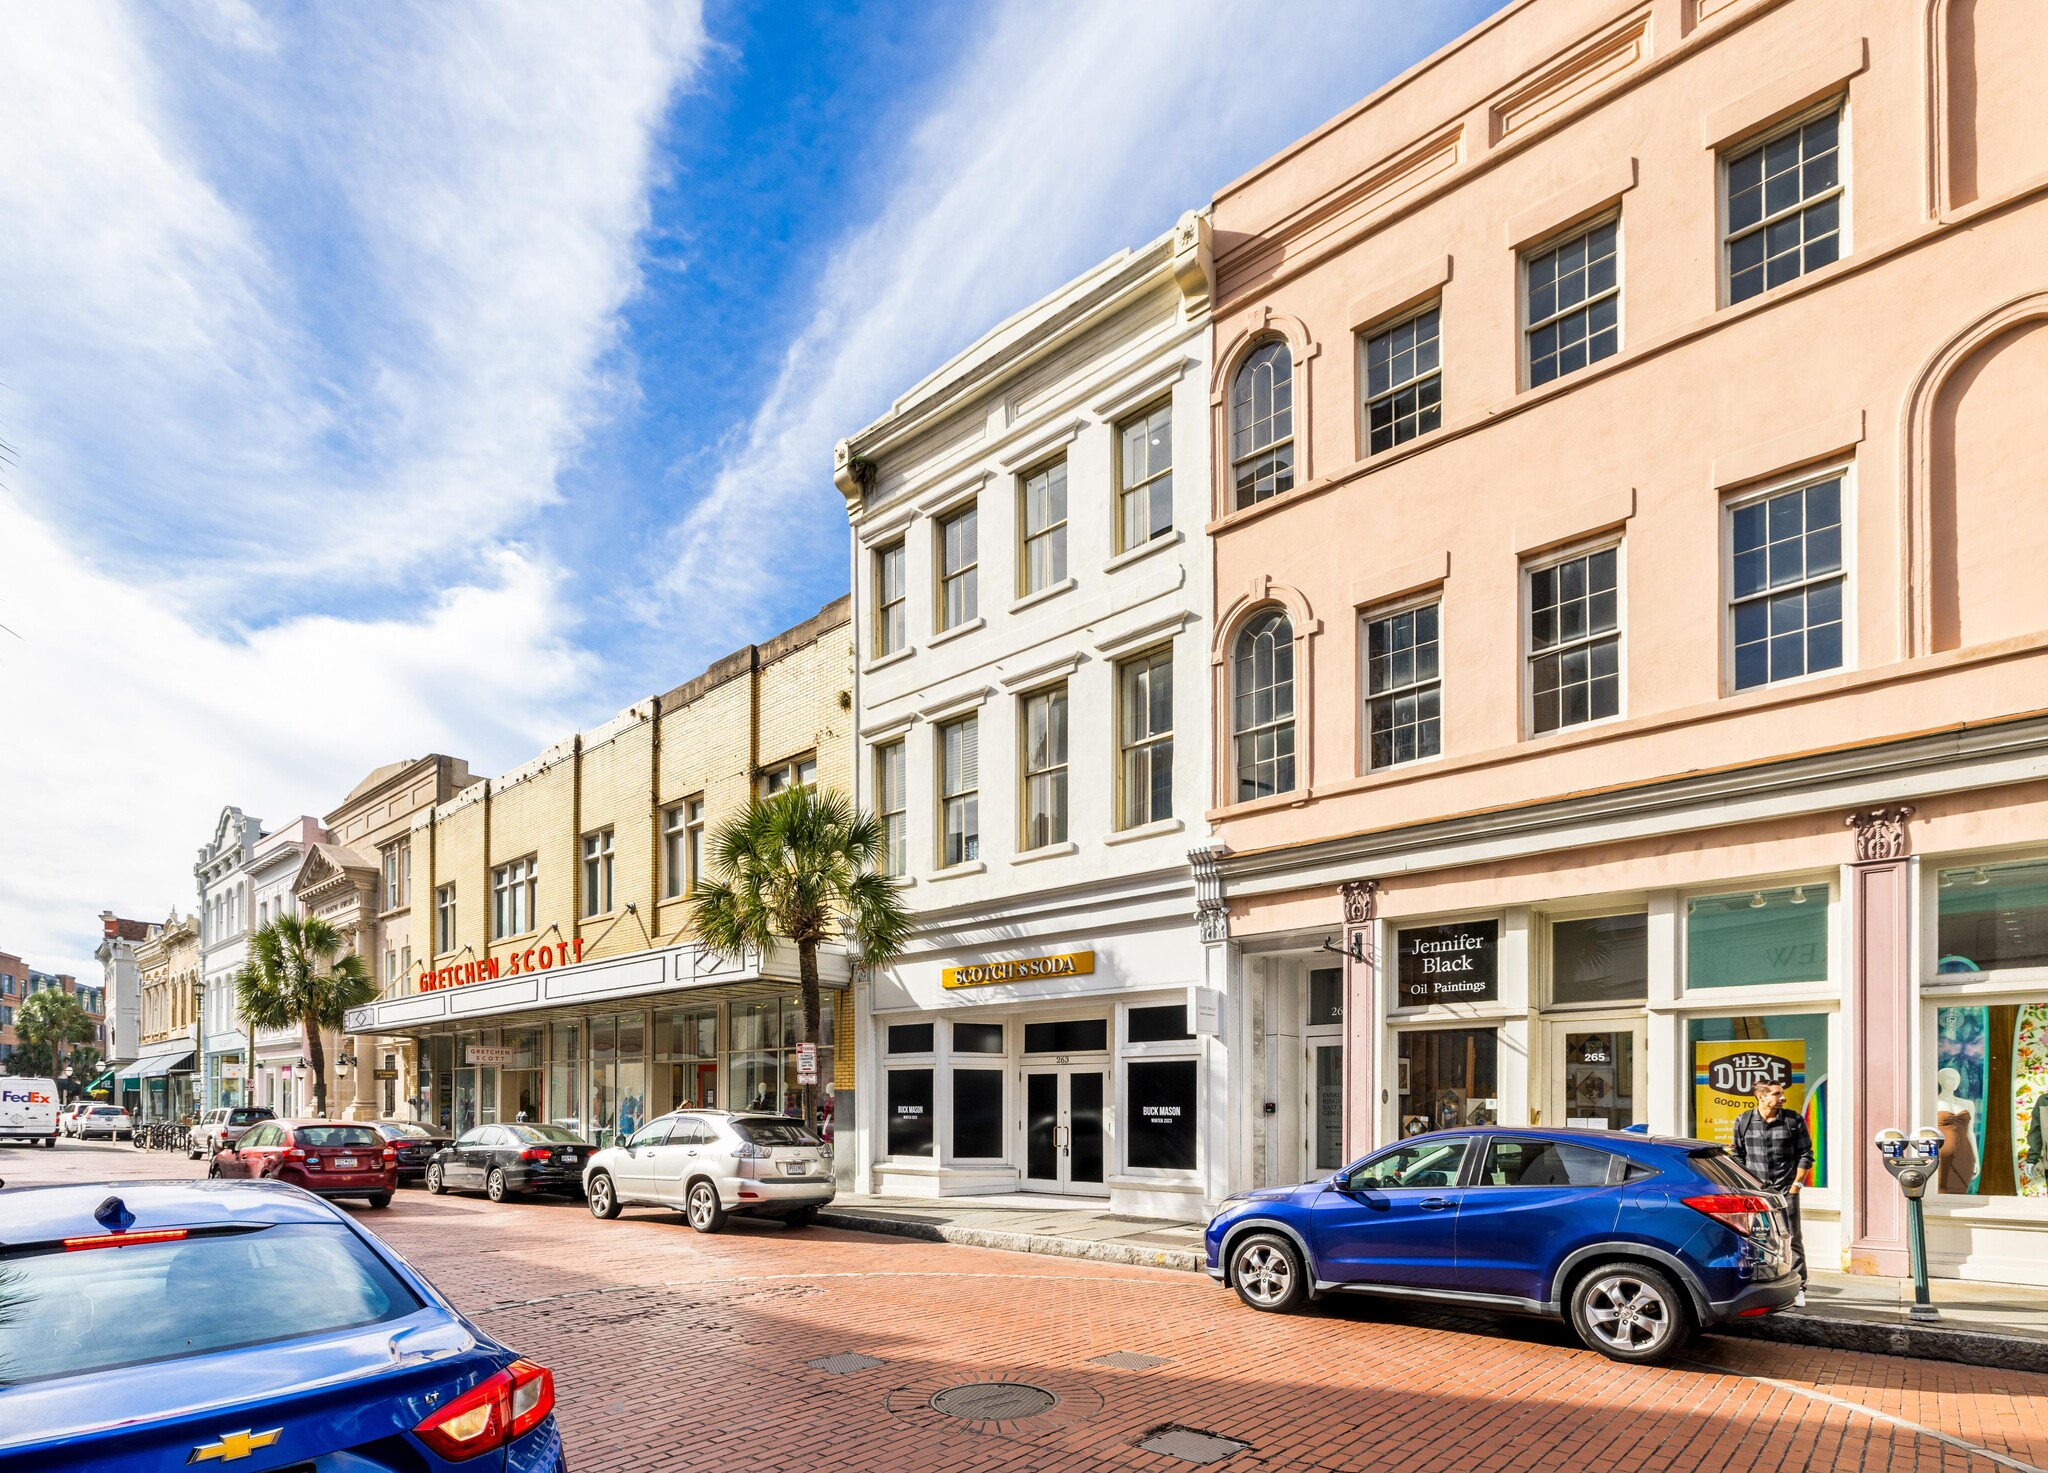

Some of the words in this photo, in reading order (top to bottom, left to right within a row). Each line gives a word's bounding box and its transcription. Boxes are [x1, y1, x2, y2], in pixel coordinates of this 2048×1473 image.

[1412, 934, 1484, 955] Jennifer
[419, 957, 499, 993] GRETCHEN
[510, 938, 584, 975] SCOTT
[954, 963, 1013, 984] SCOTCH
[1016, 962, 1028, 977] &
[1030, 956, 1075, 976] SODA
[1422, 955, 1473, 974] Black
[1411, 984, 1428, 995] Oil
[1433, 981, 1486, 995] Paintings
[1584, 1053, 1605, 1062] 265
[1733, 1055, 1772, 1069] HEY
[2, 1091, 51, 1103] FedEx
[1714, 1097, 1740, 1108] GOOD
[898, 1105, 909, 1113] BUCK
[1143, 1106, 1158, 1116] BUCK
[1159, 1106, 1181, 1116] MASON
[425, 1393, 439, 1404] LT
